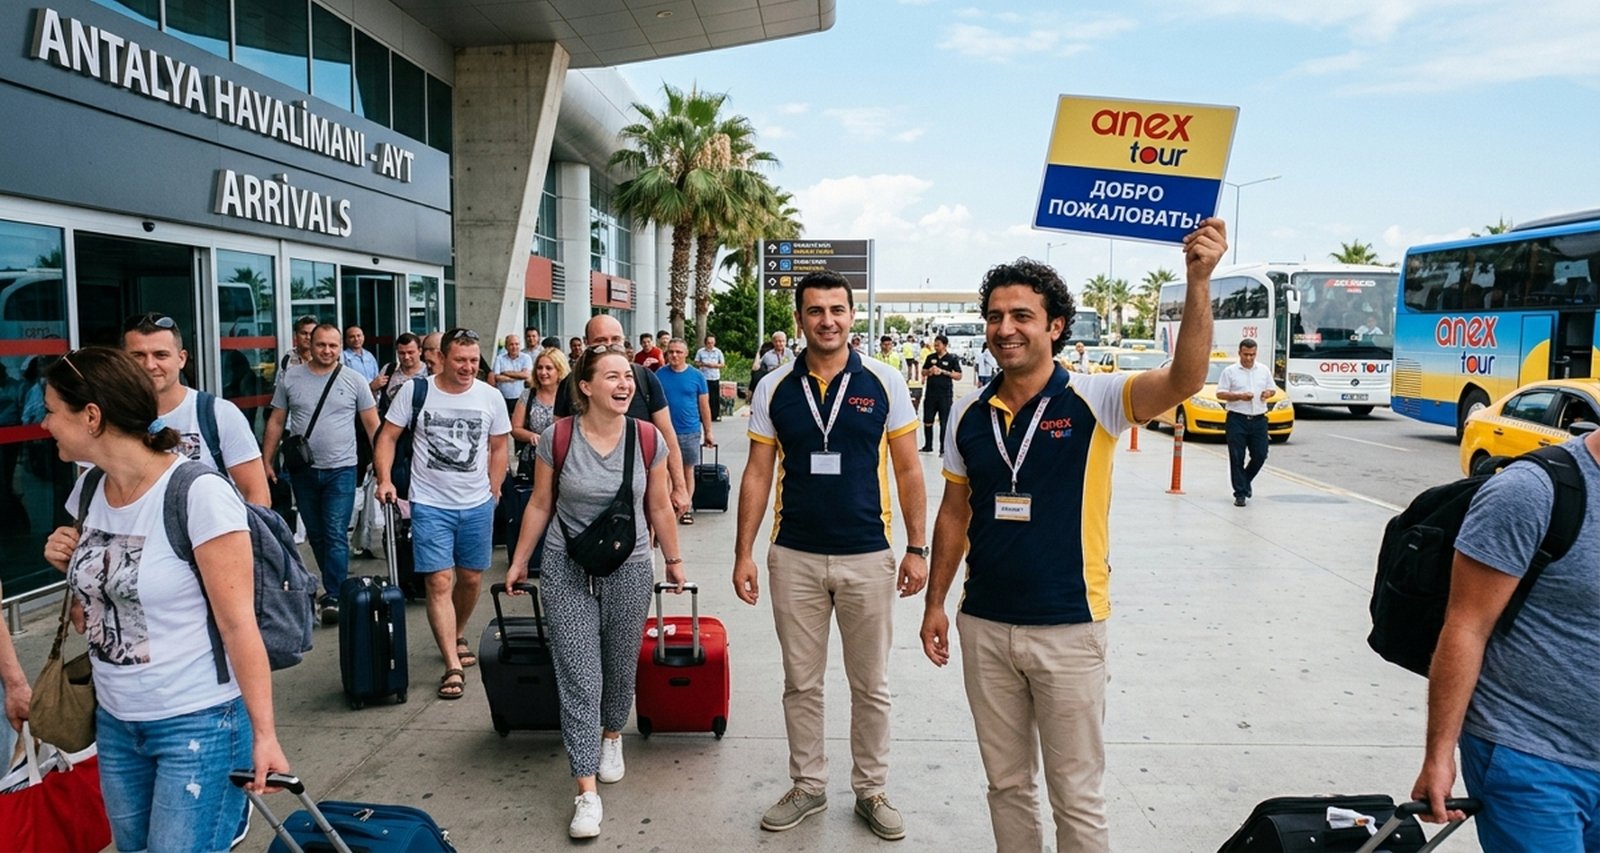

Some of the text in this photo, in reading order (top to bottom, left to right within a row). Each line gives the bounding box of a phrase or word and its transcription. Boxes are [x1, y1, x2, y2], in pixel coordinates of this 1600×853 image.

[34, 7, 207, 114] ANTALYA
[211, 74, 366, 167] HAVALİMANI
[378, 143, 415, 184] AYT
[1091, 109, 1193, 142] anex
[1129, 141, 1188, 167] tour
[1089, 179, 1164, 202] ДОБРО
[1048, 198, 1202, 230] ПОЖАЛОВАТЬ!
[1436, 316, 1498, 348] anex
[1319, 362, 1358, 373] anex
[1460, 351, 1496, 375] tour
[1040, 418, 1072, 431] anex
